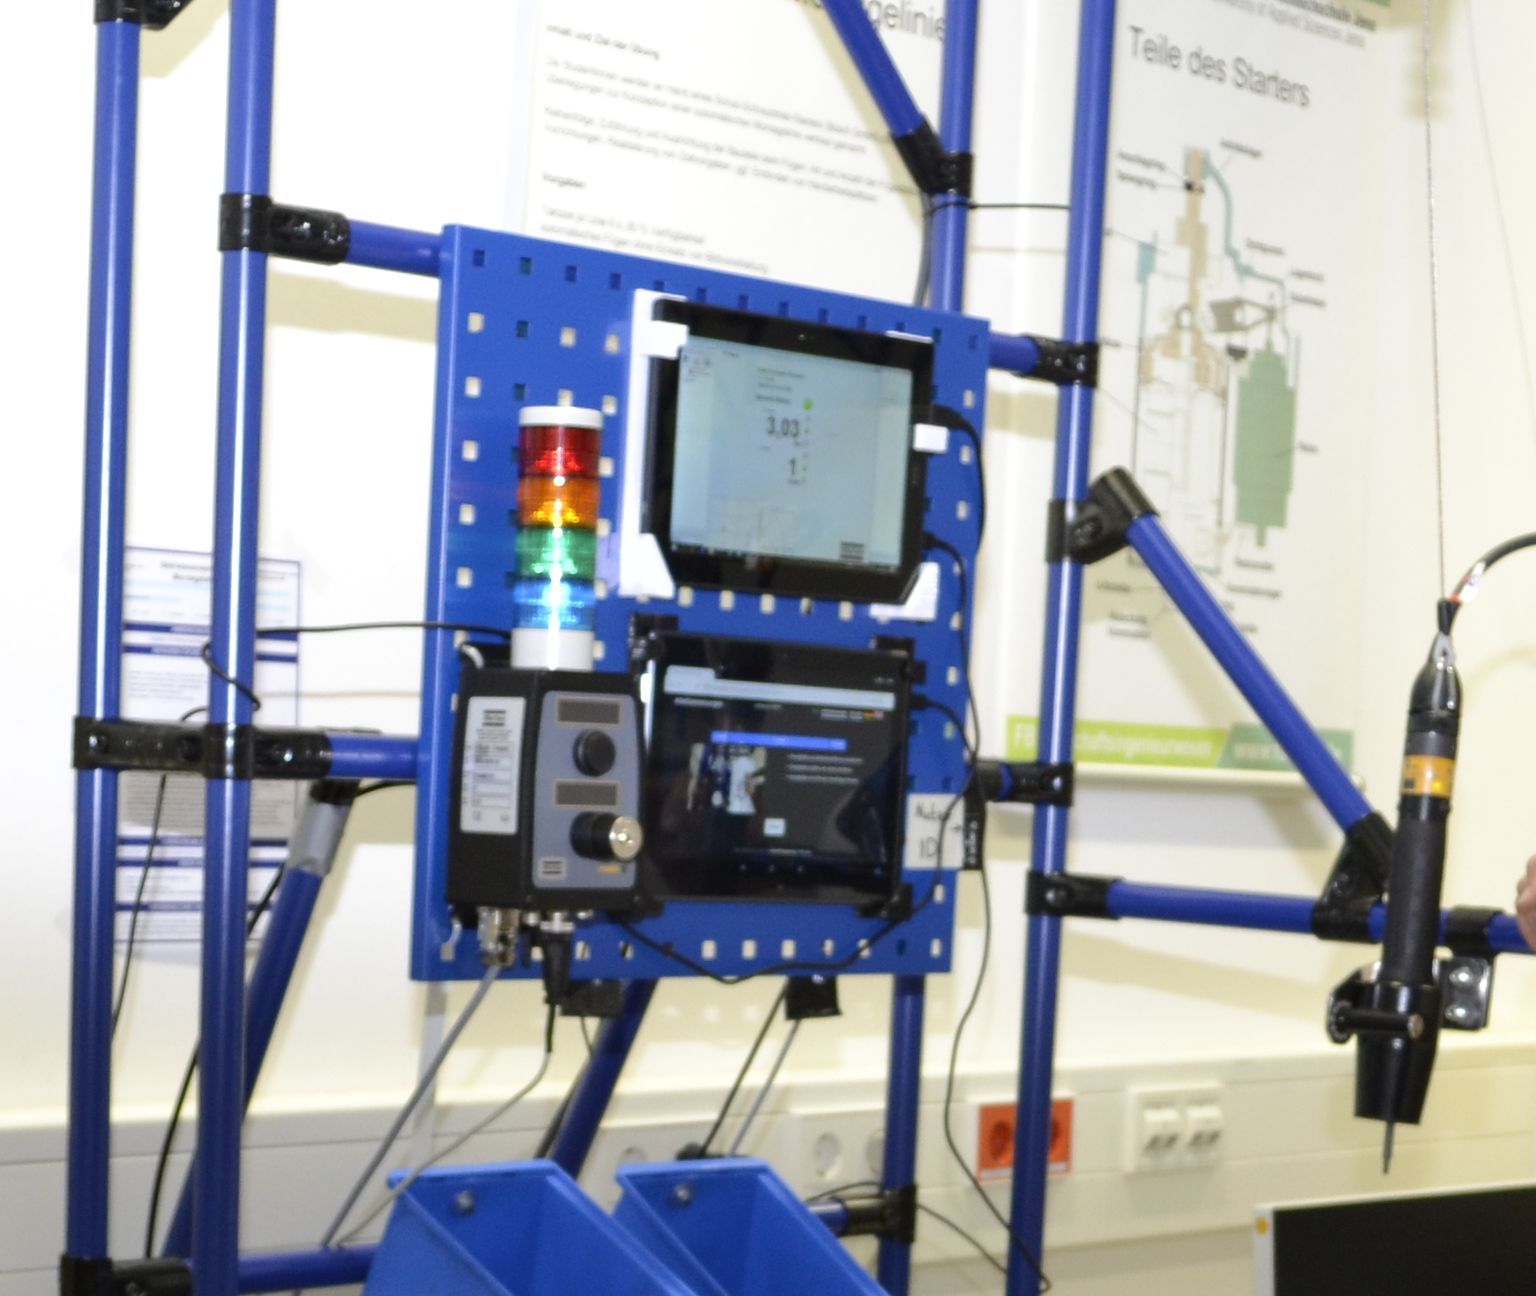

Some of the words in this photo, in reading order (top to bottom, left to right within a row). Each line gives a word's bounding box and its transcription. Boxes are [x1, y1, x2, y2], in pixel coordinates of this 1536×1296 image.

[1128, 24, 1181, 70] Teile
[1188, 45, 1226, 84] des
[1233, 56, 1310, 107] Starters
[767, 415, 800, 440] 3,03
